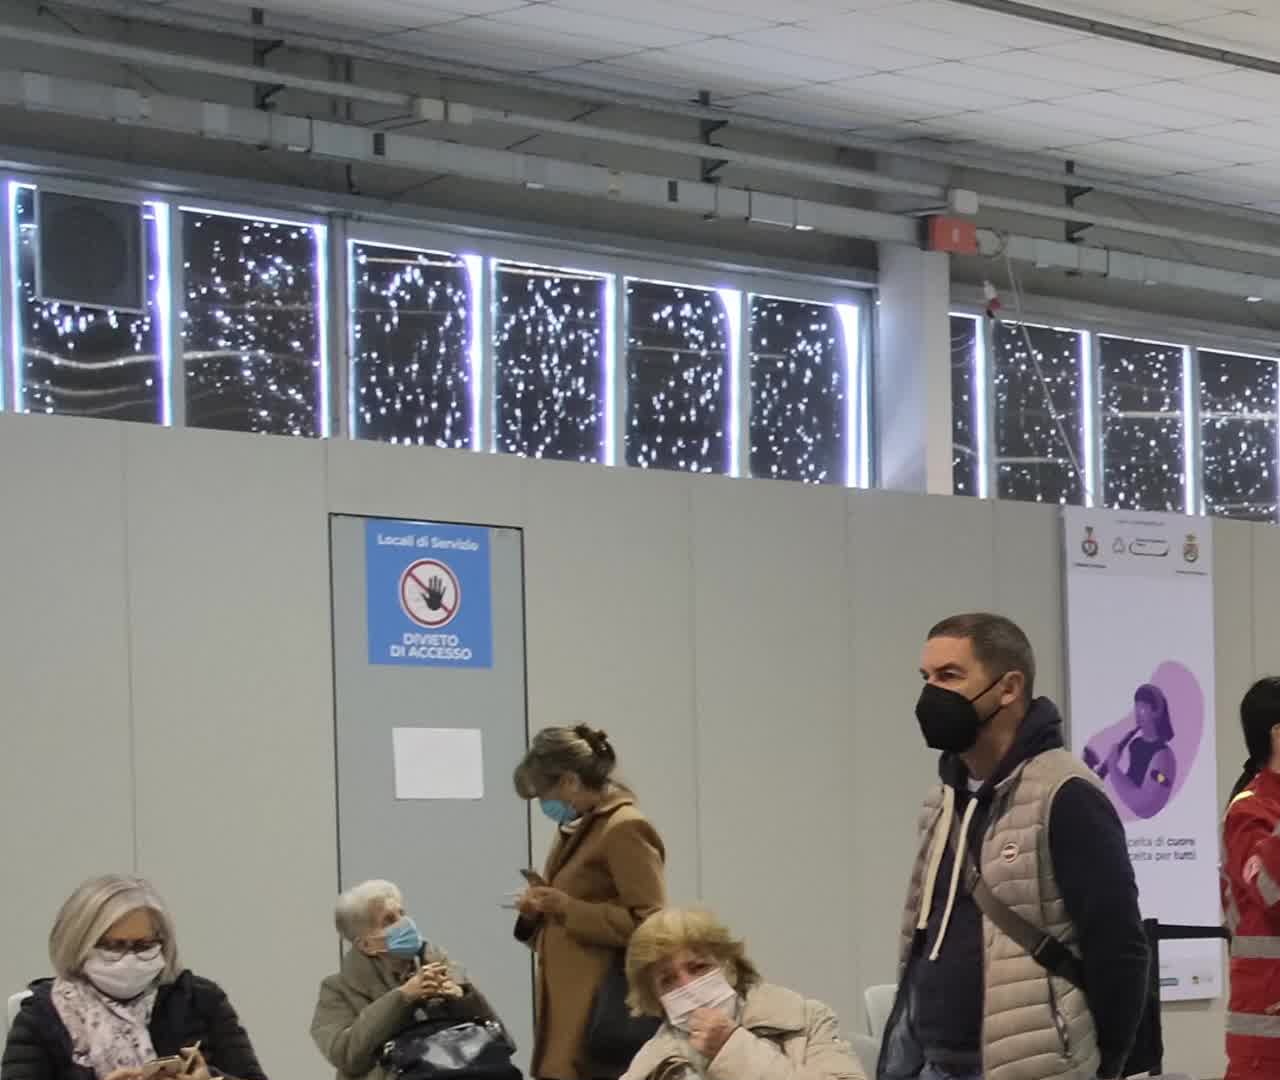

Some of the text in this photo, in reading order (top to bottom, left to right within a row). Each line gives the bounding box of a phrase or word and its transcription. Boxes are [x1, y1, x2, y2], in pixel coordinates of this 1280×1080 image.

[377, 533, 415, 548] Locali
[416, 536, 429, 548] di
[403, 632, 459, 647] DIVIETO
[389, 645, 473, 661] DI ACCESSO
